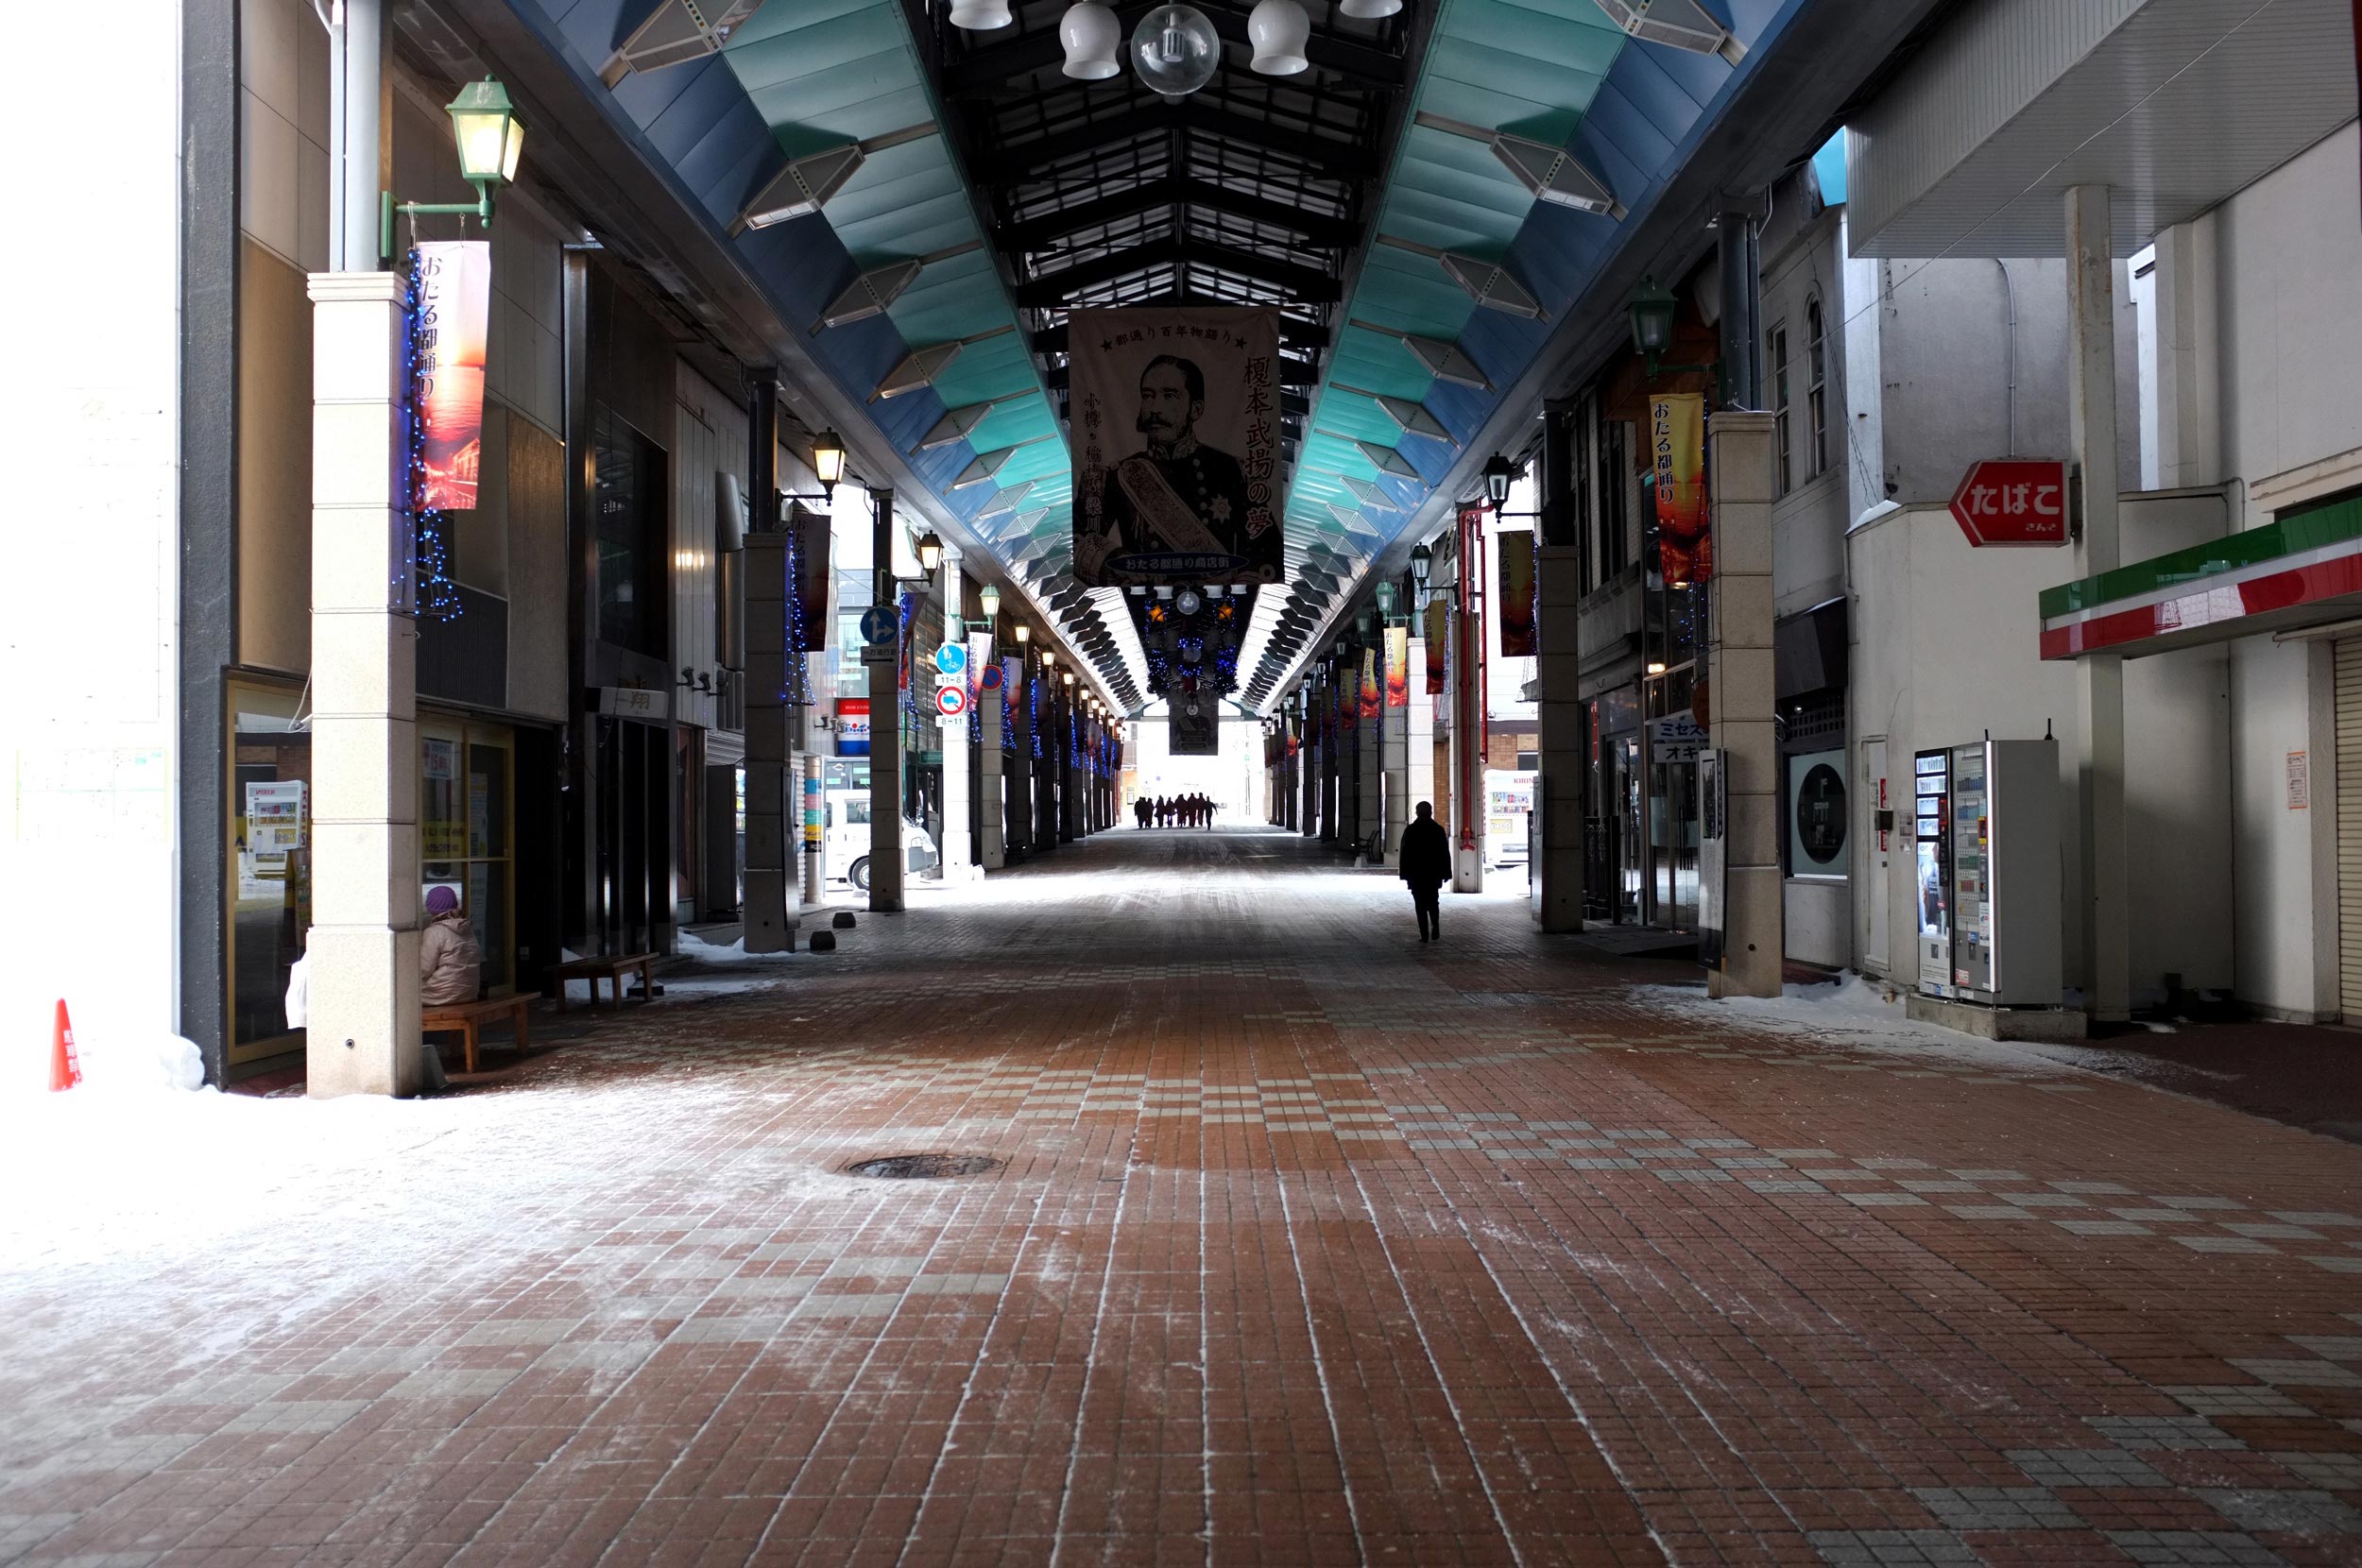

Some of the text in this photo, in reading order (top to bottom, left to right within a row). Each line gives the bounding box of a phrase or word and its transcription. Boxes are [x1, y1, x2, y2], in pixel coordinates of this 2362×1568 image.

[420, 256, 442, 401] おたる都通り
[1243, 356, 1274, 539] 榎本武揚の夢
[1654, 403, 1673, 503] おたる都通り
[1970, 482, 2060, 515] たばこ
[1126, 556, 1230, 570] おたる都通り商店街
[1661, 724, 1708, 736] ミセス
